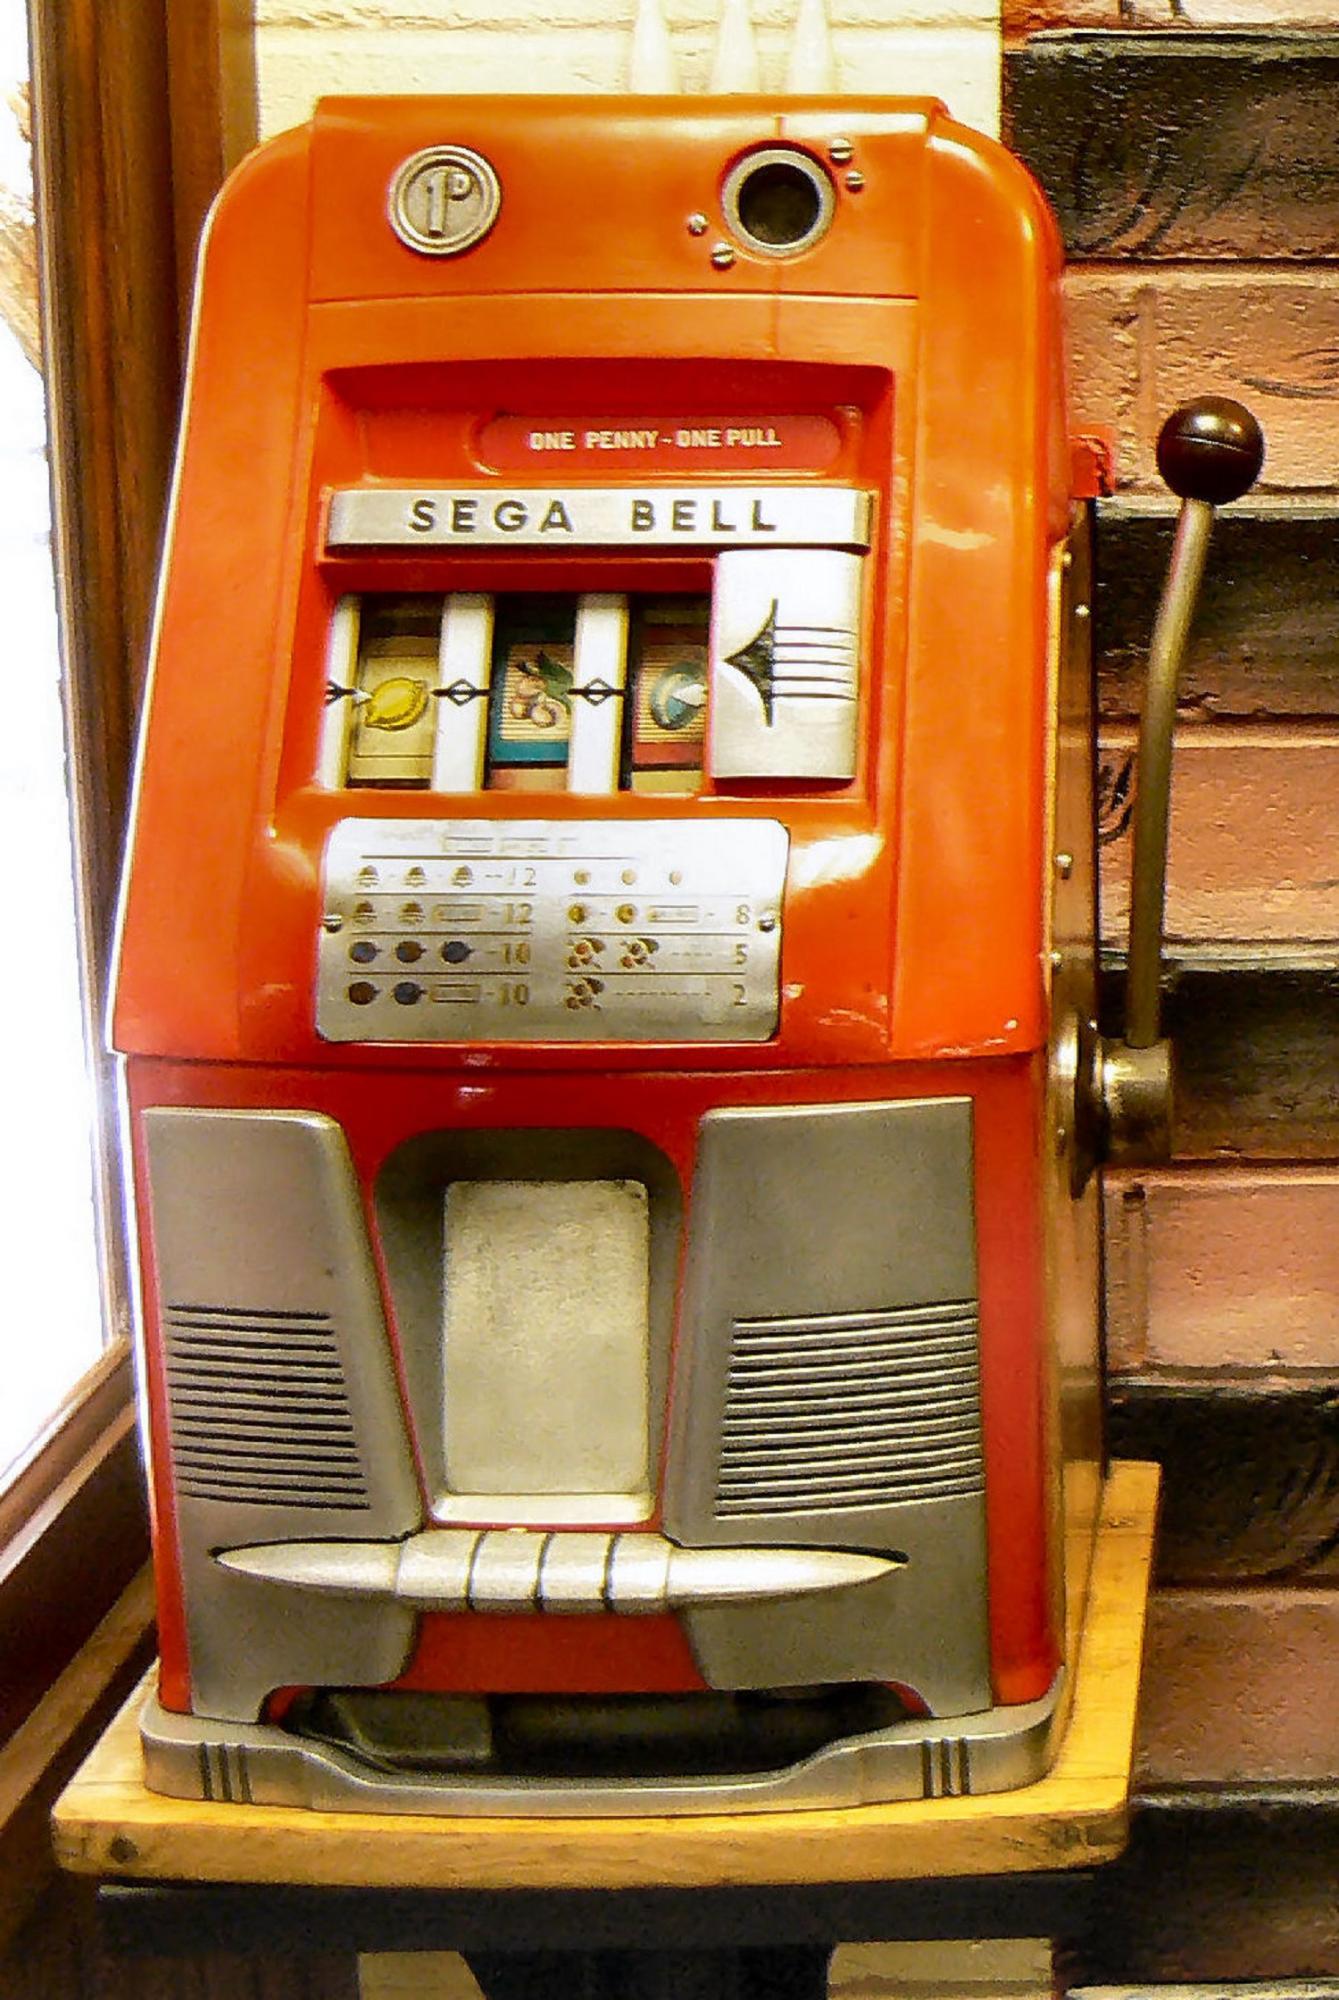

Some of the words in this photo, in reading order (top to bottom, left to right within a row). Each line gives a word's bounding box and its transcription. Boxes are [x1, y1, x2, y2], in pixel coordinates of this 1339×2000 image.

[529, 432, 576, 450] ONE
[585, 431, 658, 450] PENNY
[675, 430, 722, 448] ONE
[726, 429, 782, 447] PULL
[408, 499, 574, 533] SEGA
[631, 499, 777, 533] BELL
[504, 903, 534, 924] 12
[735, 904, 750, 924] 8
[735, 943, 748, 965] 5
[500, 982, 529, 1006] 10
[733, 984, 748, 1006] 2
